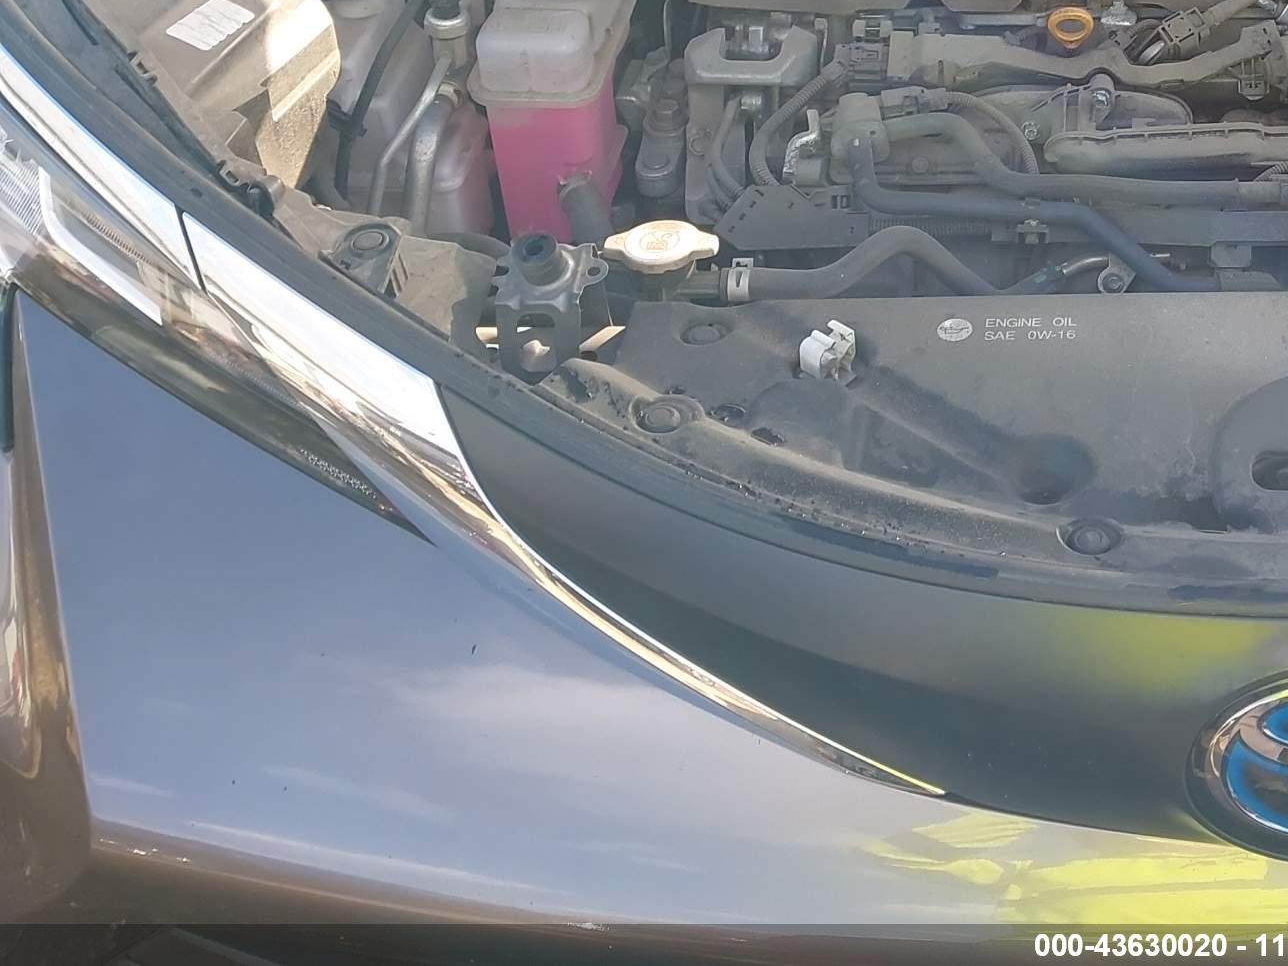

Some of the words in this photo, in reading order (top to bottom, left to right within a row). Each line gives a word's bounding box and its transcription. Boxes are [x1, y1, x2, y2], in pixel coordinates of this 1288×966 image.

[985, 317, 1041, 327] ENGINE
[1052, 317, 1077, 326] OIL
[984, 330, 1015, 340] SAE
[1028, 330, 1076, 339] 0W-16
